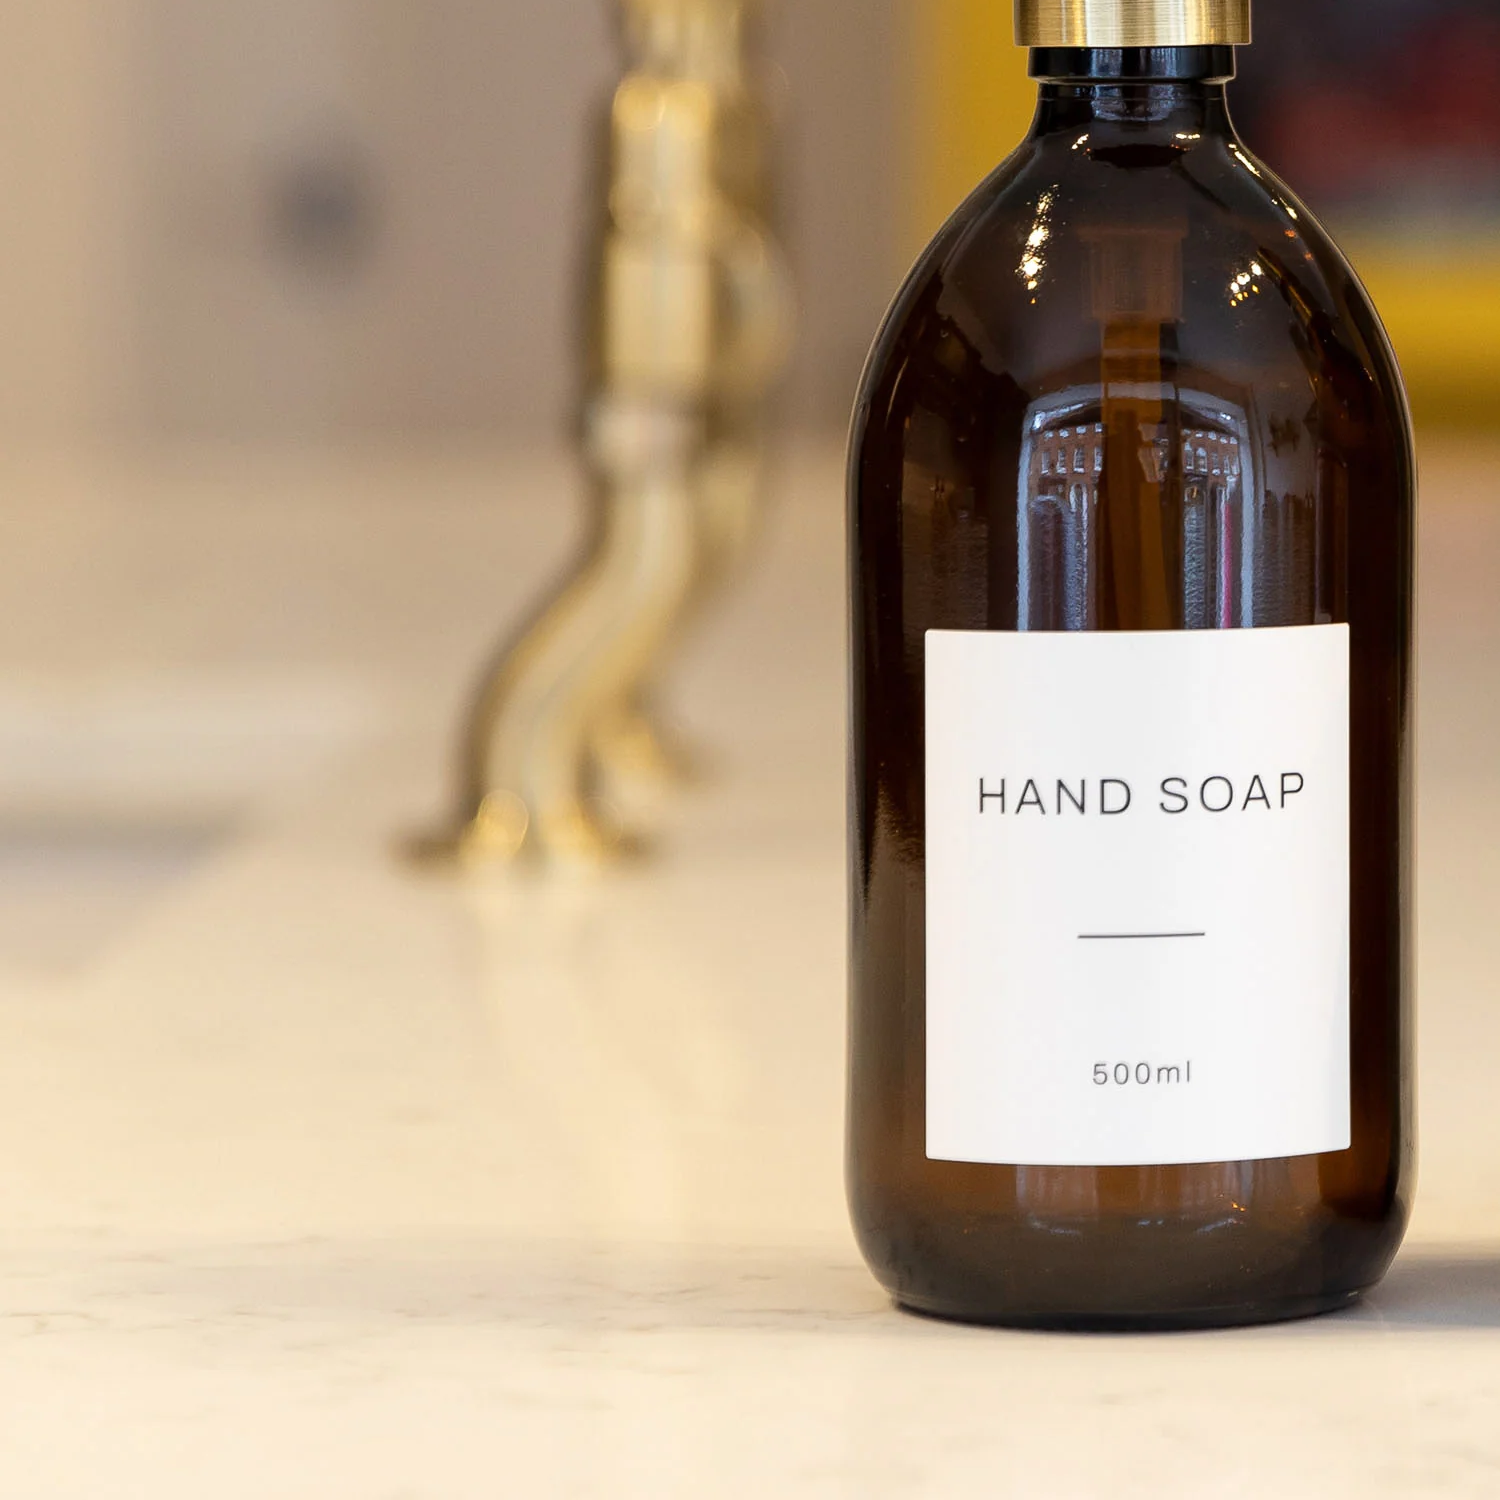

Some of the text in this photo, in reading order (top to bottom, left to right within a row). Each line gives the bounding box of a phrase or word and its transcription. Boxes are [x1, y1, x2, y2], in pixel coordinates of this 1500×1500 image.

[978, 771, 1305, 816] HAND SOAP
[1092, 1060, 1191, 1086] 500ml
